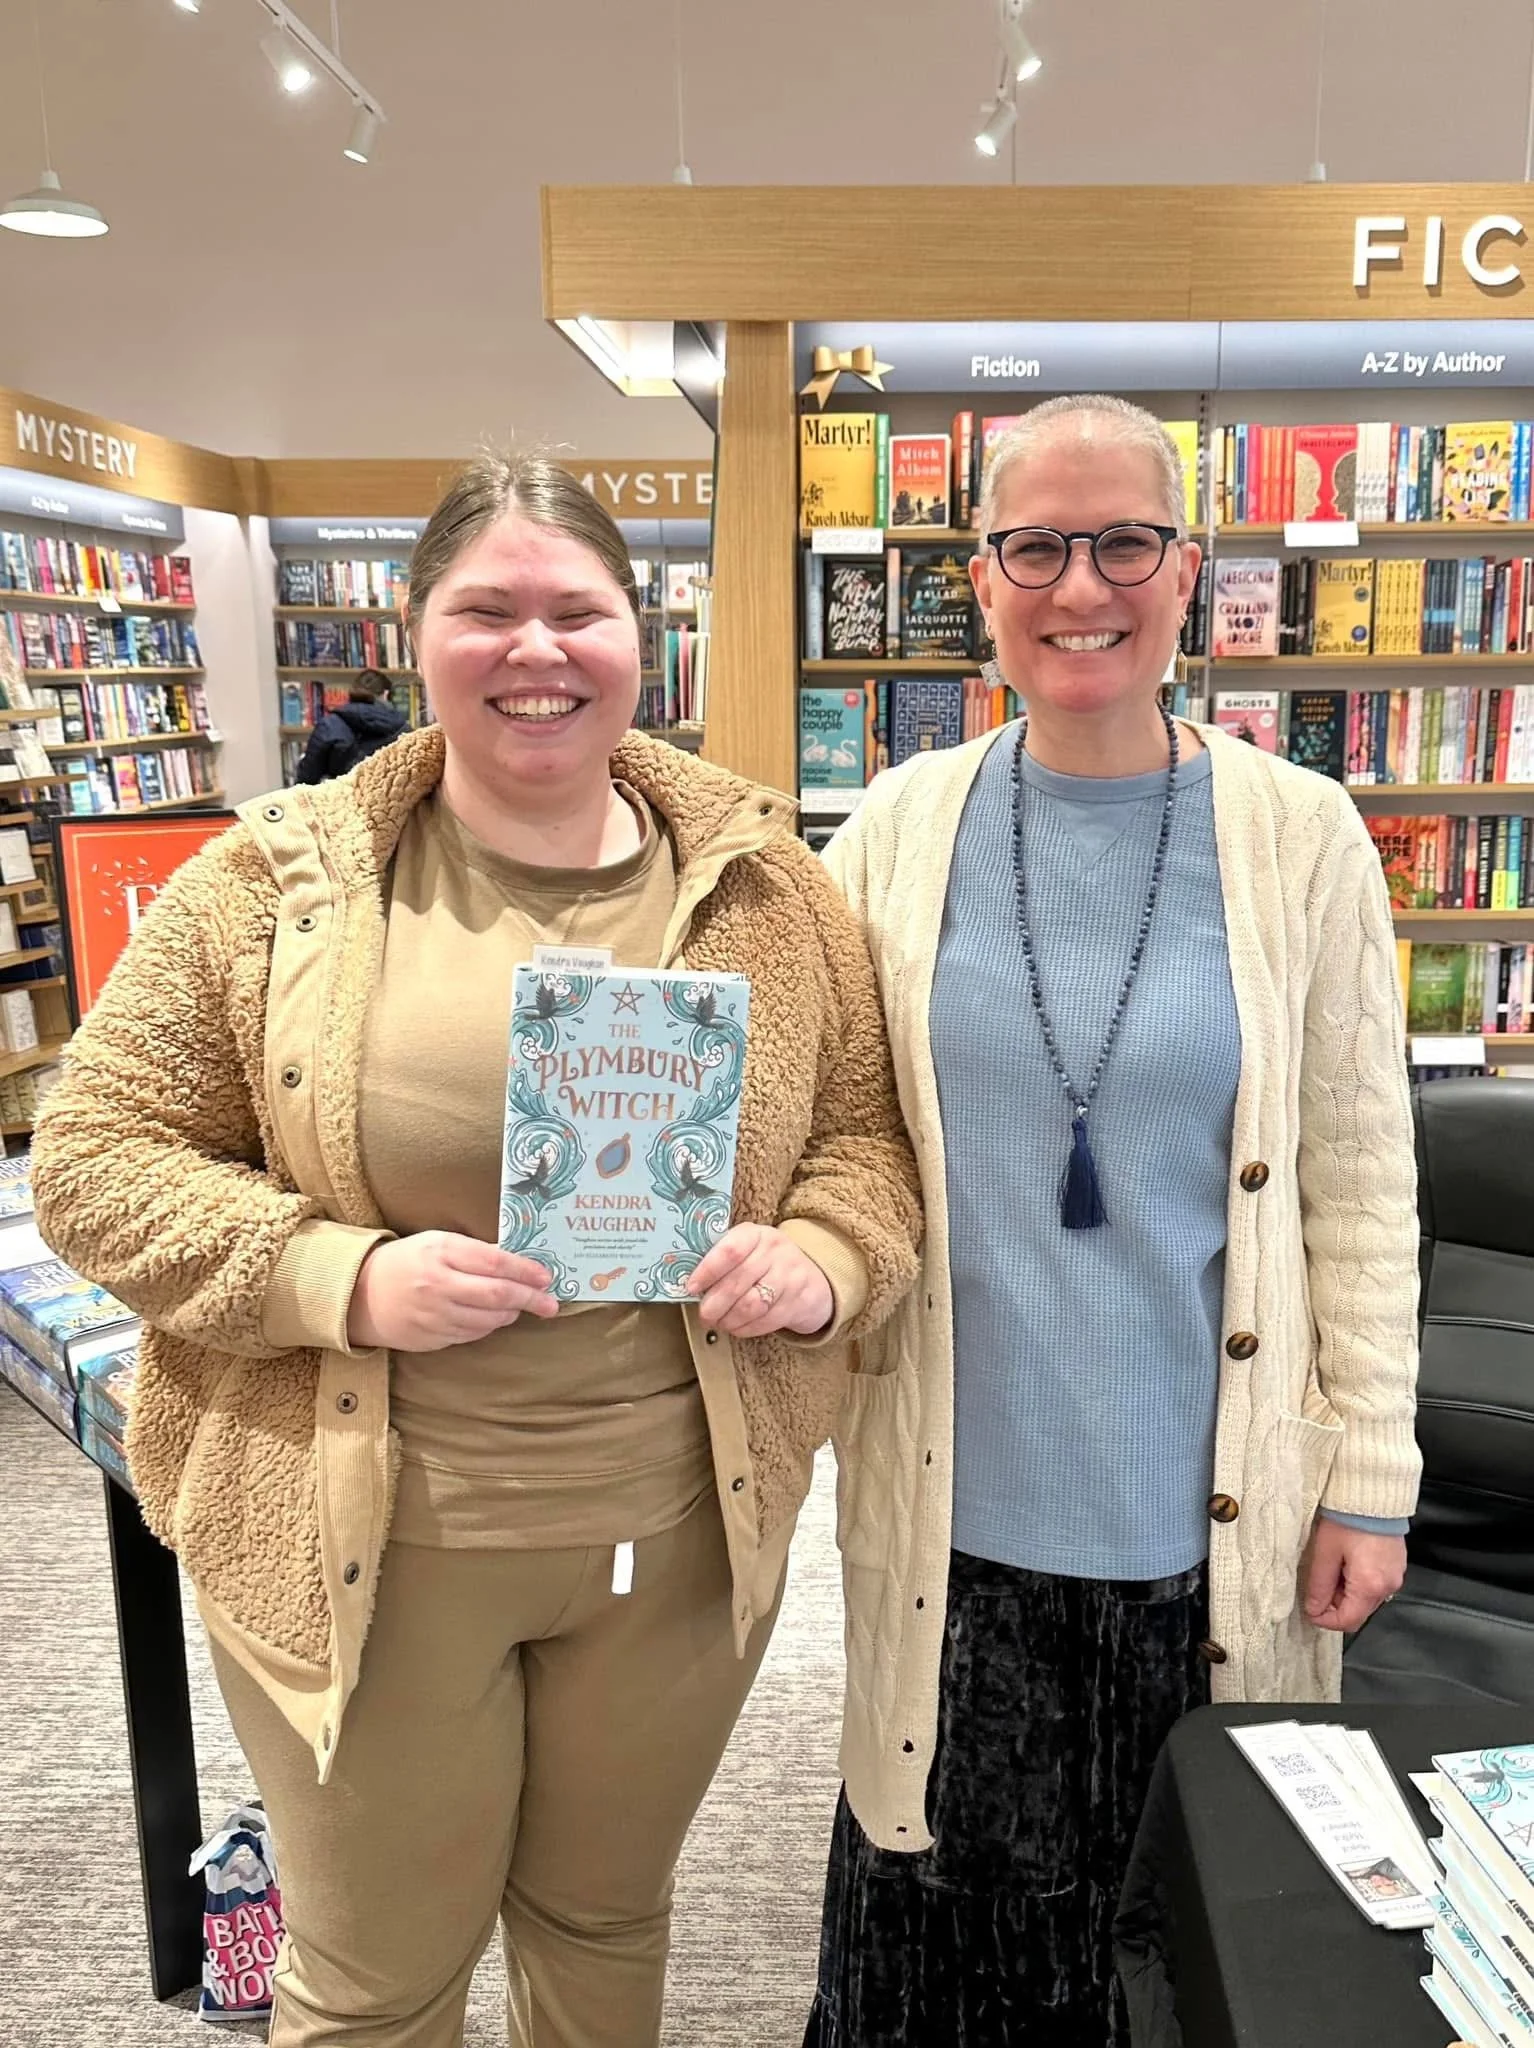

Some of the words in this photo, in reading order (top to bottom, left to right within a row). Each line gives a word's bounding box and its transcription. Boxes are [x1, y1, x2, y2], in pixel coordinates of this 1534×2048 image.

[1352, 214, 1524, 287] FIC
[971, 355, 1040, 377] Fiction
[1361, 351, 1399, 373] A-Z
[1403, 351, 1428, 377] by
[1432, 350, 1505, 372] Author
[804, 418, 871, 451] Martyr!
[16, 409, 137, 479] MYSTERY
[899, 446, 940, 460] Mitch
[896, 461, 942, 476] Albom
[805, 510, 837, 528] Kaveh
[839, 510, 869, 528] Akbar
[832, 567, 866, 590] THE
[927, 575, 947, 585] THE
[1319, 561, 1372, 587] Martyr!
[841, 581, 885, 607] NEW
[915, 589, 958, 600] BALLAD
[905, 614, 968, 625] JACQUOTTE
[909, 628, 964, 639] DELAHAYE
[802, 694, 822, 706] the
[1225, 699, 1271, 708] GHOSTS
[802, 708, 843, 721] happy
[802, 719, 843, 732] couple
[608, 1023, 641, 1040] THE
[532, 1045, 710, 1092] PLYMBURY
[558, 1085, 676, 1121] WITCH
[574, 1194, 653, 1211] KENDRA
[565, 1214, 658, 1233] VAUGHAN
[207, 1948, 230, 1979] &
